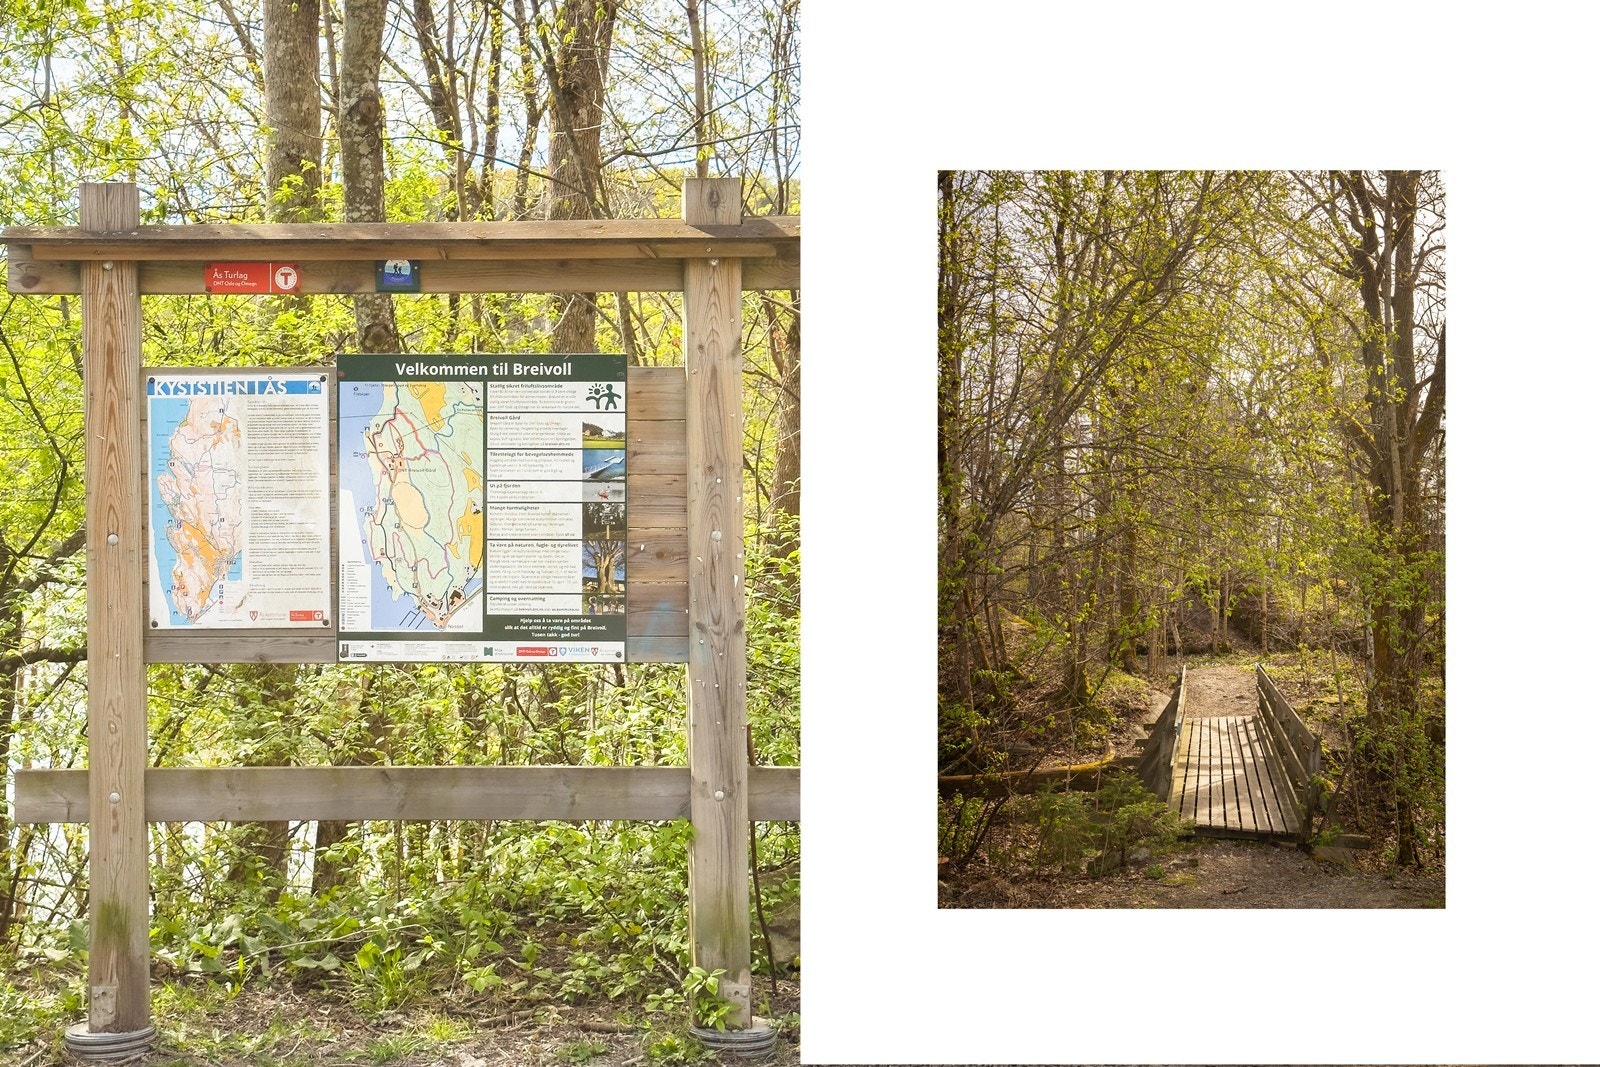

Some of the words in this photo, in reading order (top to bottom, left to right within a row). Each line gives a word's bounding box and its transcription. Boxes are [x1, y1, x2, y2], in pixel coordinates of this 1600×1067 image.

[213, 268, 222, 278] Ås
[224, 271, 248, 280] Turlag
[395, 362, 488, 376] Velkommen
[492, 362, 508, 376] til
[514, 362, 572, 376] Breivoll
[154, 380, 249, 395] KYSTSTIEN
[264, 376, 288, 395] ÅS
